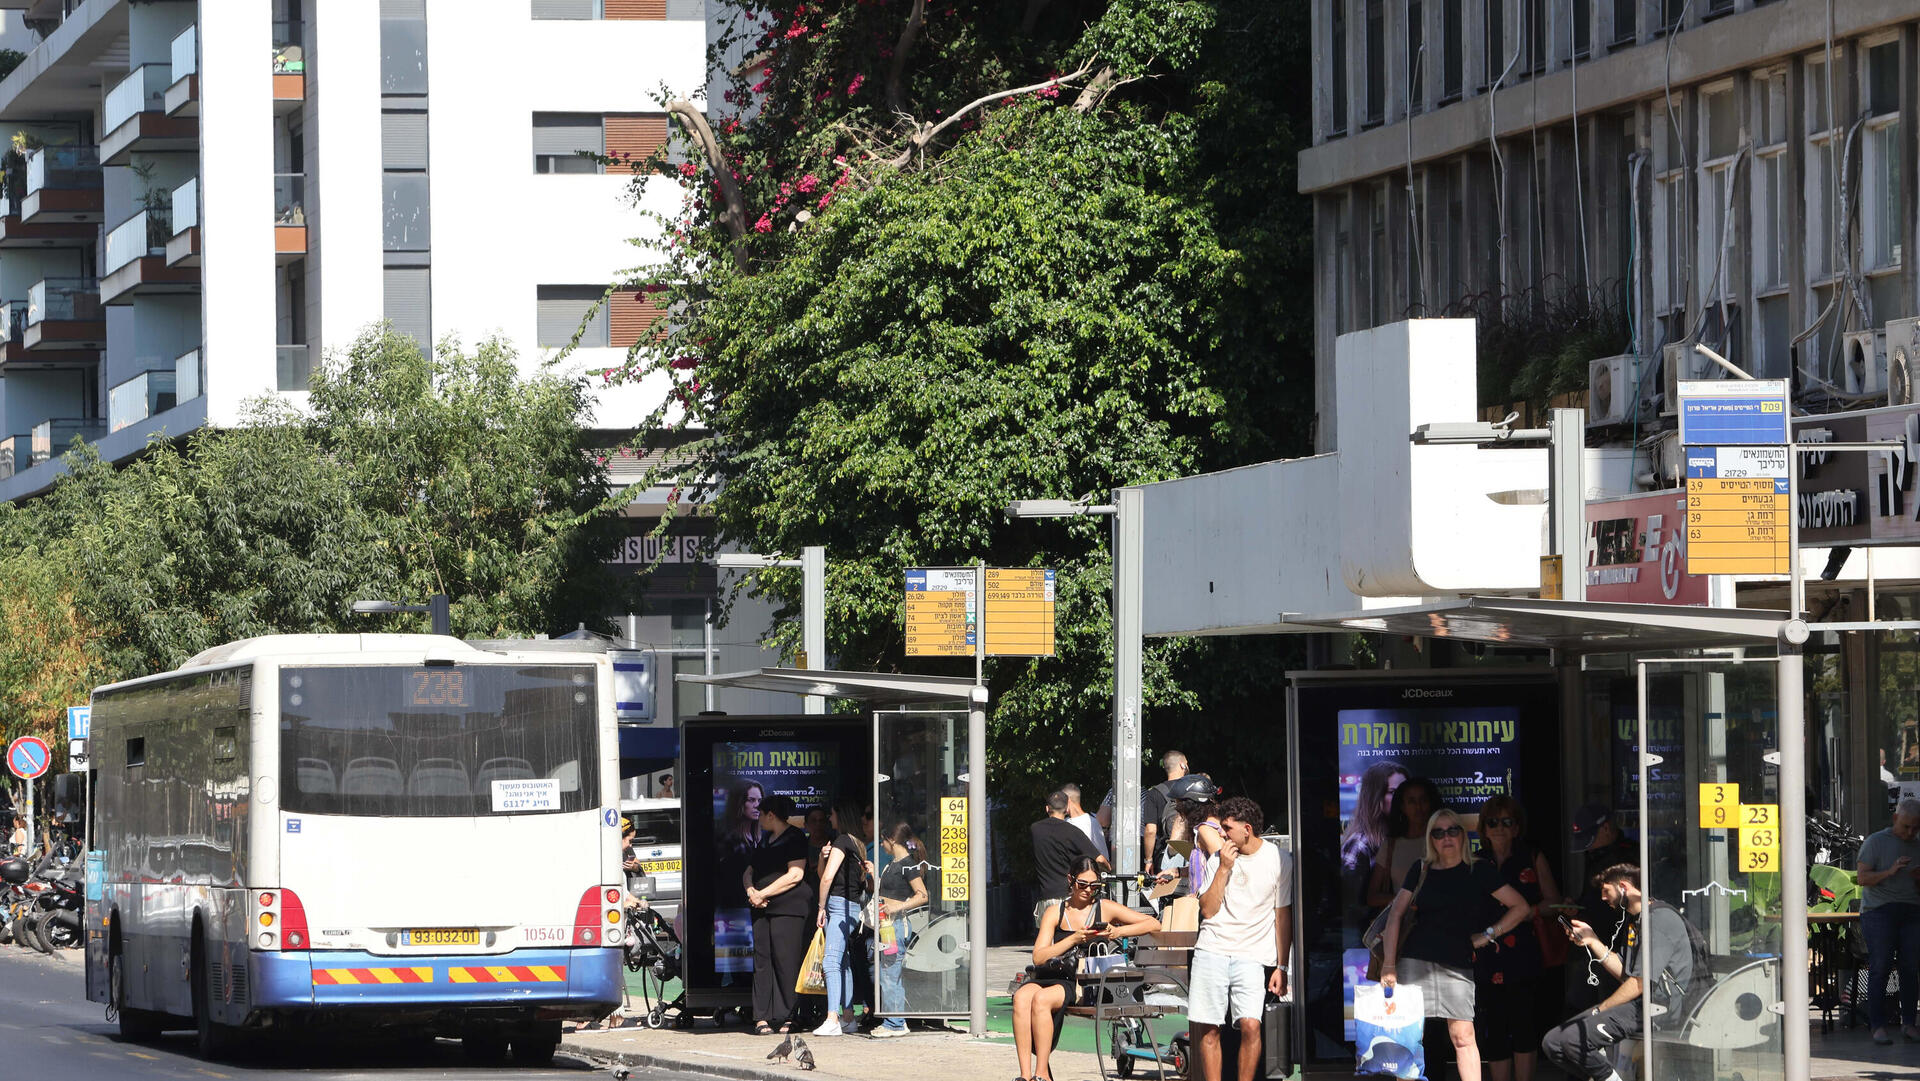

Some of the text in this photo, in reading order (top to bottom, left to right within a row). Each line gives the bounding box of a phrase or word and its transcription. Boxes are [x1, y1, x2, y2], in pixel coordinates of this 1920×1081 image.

[1763, 403, 1781, 411] 709
[1758, 460, 1785, 470] קרליבך
[1690, 481, 1703, 492] 3,9
[1720, 481, 1773, 490] מסוף הטייסים
[1690, 497, 1701, 506] 23
[1798, 489, 1855, 529] החשמונ
[1690, 513, 1701, 522] 39
[1748, 512, 1755, 520] גן
[1690, 529, 1701, 538] 63
[1748, 527, 1774, 536] רמת גן
[412, 671, 464, 704] 238
[1401, 688, 1453, 698] JCDecaux
[1342, 720, 1515, 748] עיתונאית חוקרת
[1446, 747, 1461, 755] הכל
[1474, 771, 1484, 784] 2
[1485, 776, 1502, 784] זוכת
[808, 786, 815, 795] 2
[1465, 784, 1504, 795] הילארי
[1714, 786, 1724, 803] 3
[949, 799, 964, 811] 64
[950, 814, 963, 825] 74
[1714, 807, 1726, 824] 9
[1748, 808, 1768, 823] 23
[942, 827, 967, 840] 238
[1752, 830, 1773, 846] 63
[942, 842, 967, 854] 289
[951, 857, 966, 869] 26
[1748, 852, 1769, 868] 39
[946, 873, 967, 884] 126
[946, 887, 966, 898] 189
[524, 928, 565, 941] 10540
